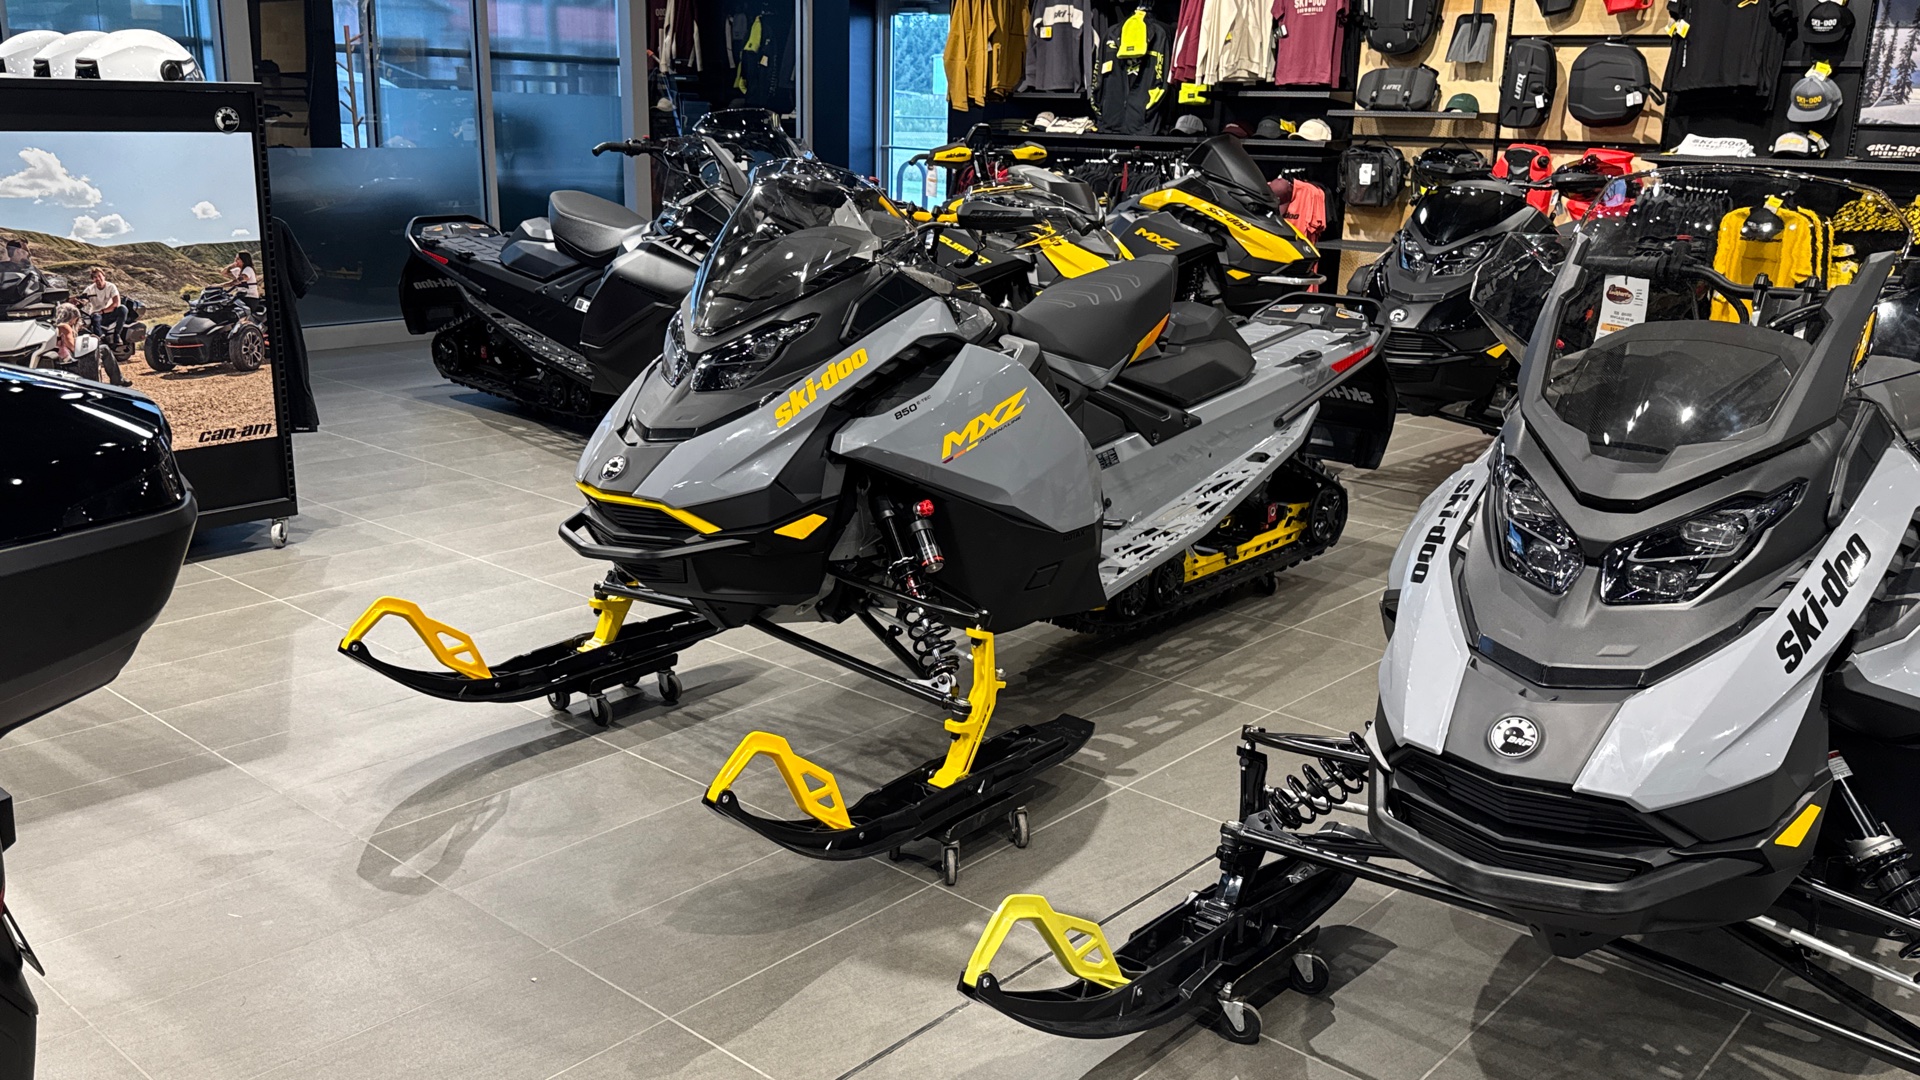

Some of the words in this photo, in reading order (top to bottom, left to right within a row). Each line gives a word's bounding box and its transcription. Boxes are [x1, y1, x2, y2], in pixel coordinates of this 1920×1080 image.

[1134, 226, 1181, 251] MXZ
[774, 347, 869, 429] ski-doo
[894, 403, 918, 420] 850
[941, 386, 1028, 460] MXZ
[199, 423, 272, 443] can-am
[1062, 530, 1086, 543] ROTAX
[1410, 479, 1475, 584] ski-doo
[1776, 532, 1872, 675] ski-doo
[1506, 735, 1533, 747] BRP
